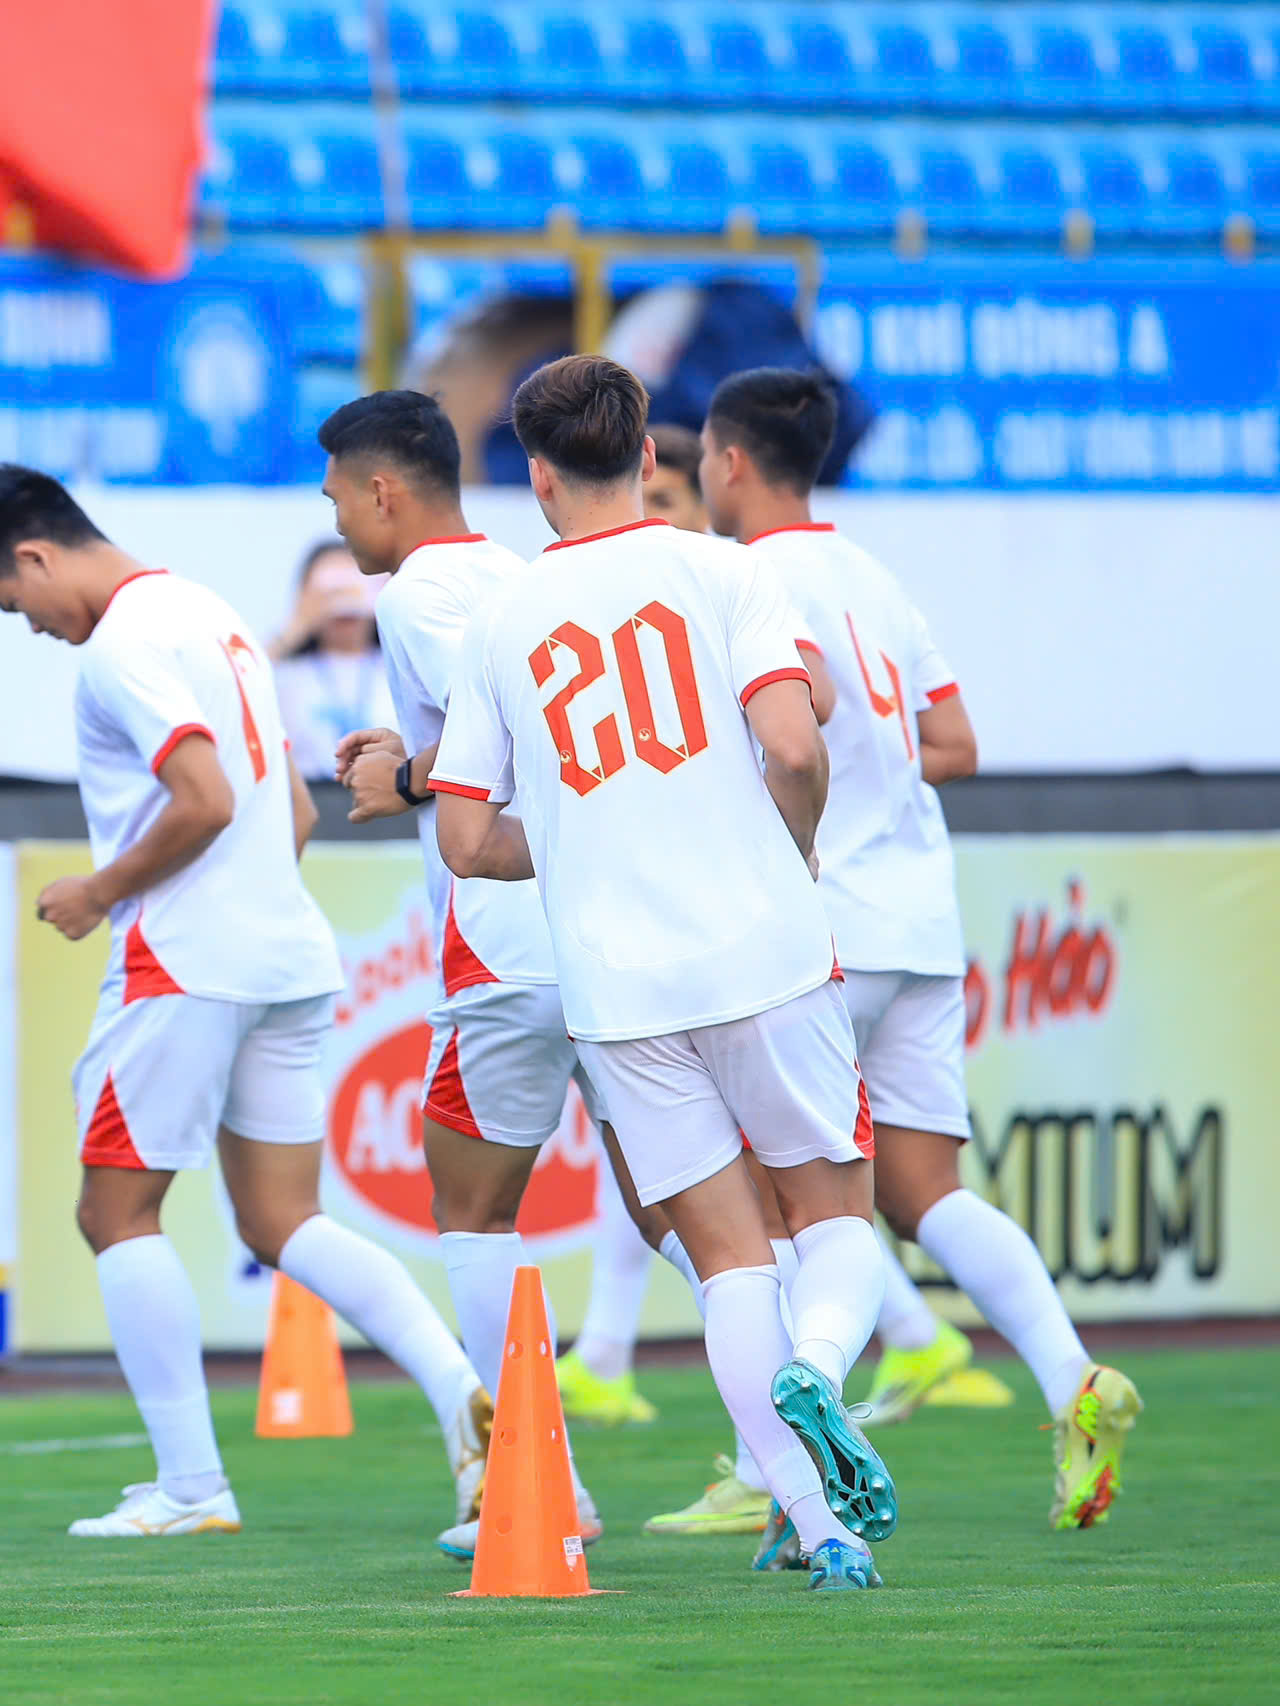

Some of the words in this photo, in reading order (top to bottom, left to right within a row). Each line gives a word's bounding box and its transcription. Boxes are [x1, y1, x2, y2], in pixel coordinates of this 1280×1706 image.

[528, 600, 708, 797] 20
[845, 610, 915, 763] 4
[960, 1104, 1224, 1283] MIUM
